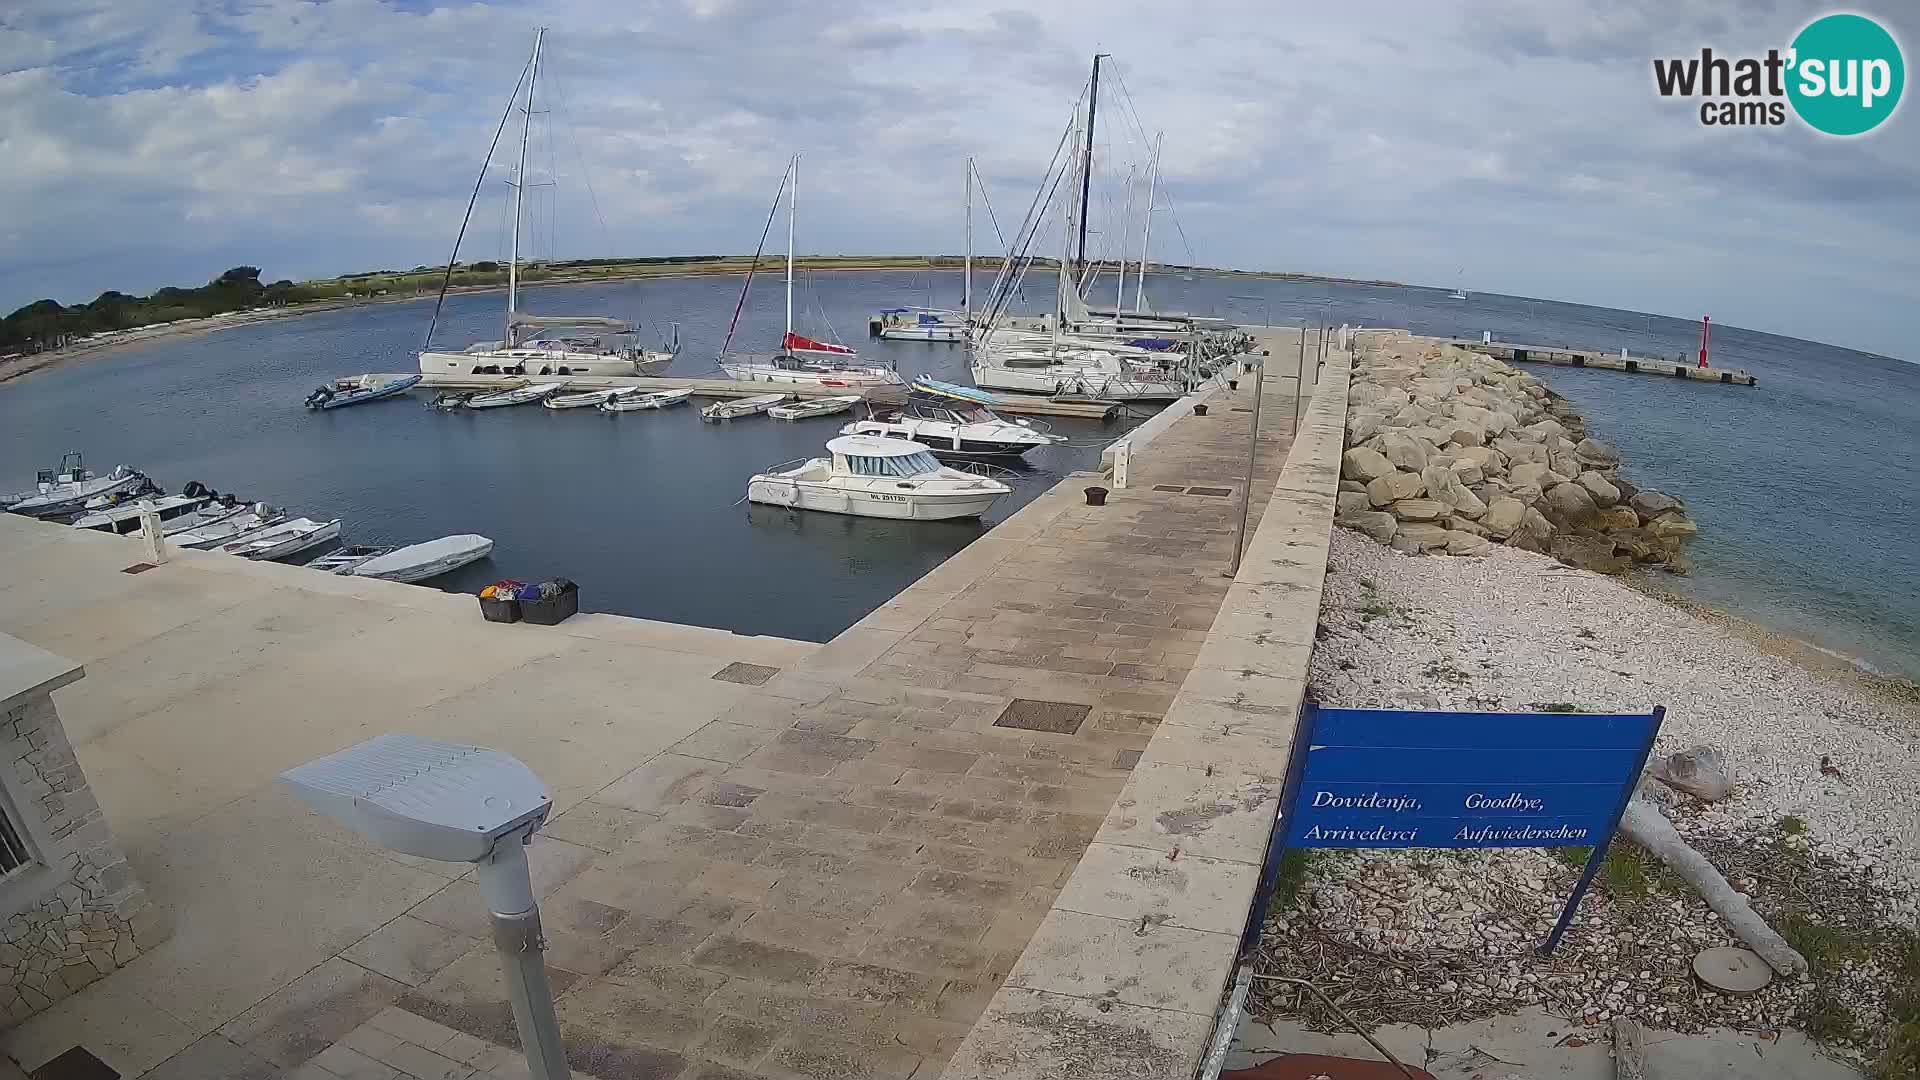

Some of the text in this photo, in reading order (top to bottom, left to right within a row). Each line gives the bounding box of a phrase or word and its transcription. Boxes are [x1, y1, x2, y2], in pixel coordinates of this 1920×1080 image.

[1465, 793, 1545, 812] Goodbye,
[1304, 824, 1588, 843] Arrivederci Aufwiedersehen
